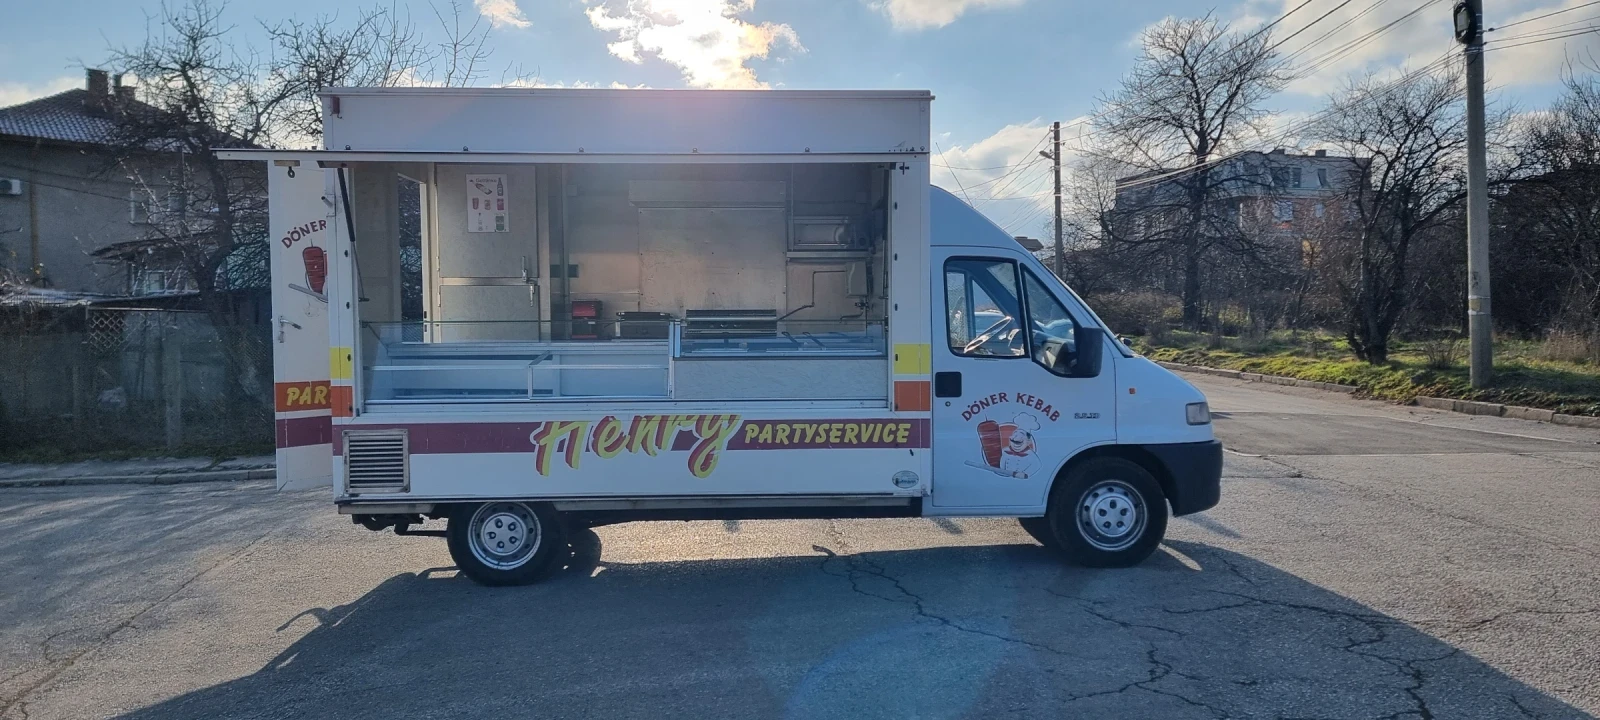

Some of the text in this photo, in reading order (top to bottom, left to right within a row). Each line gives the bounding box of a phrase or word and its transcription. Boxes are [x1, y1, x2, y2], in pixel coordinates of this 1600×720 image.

[281, 219, 327, 249] DÖNER
[286, 385, 331, 406] PAR
[961, 392, 1060, 422] DÖNER KEBAB
[744, 423, 911, 444] PARTYSERVICE
